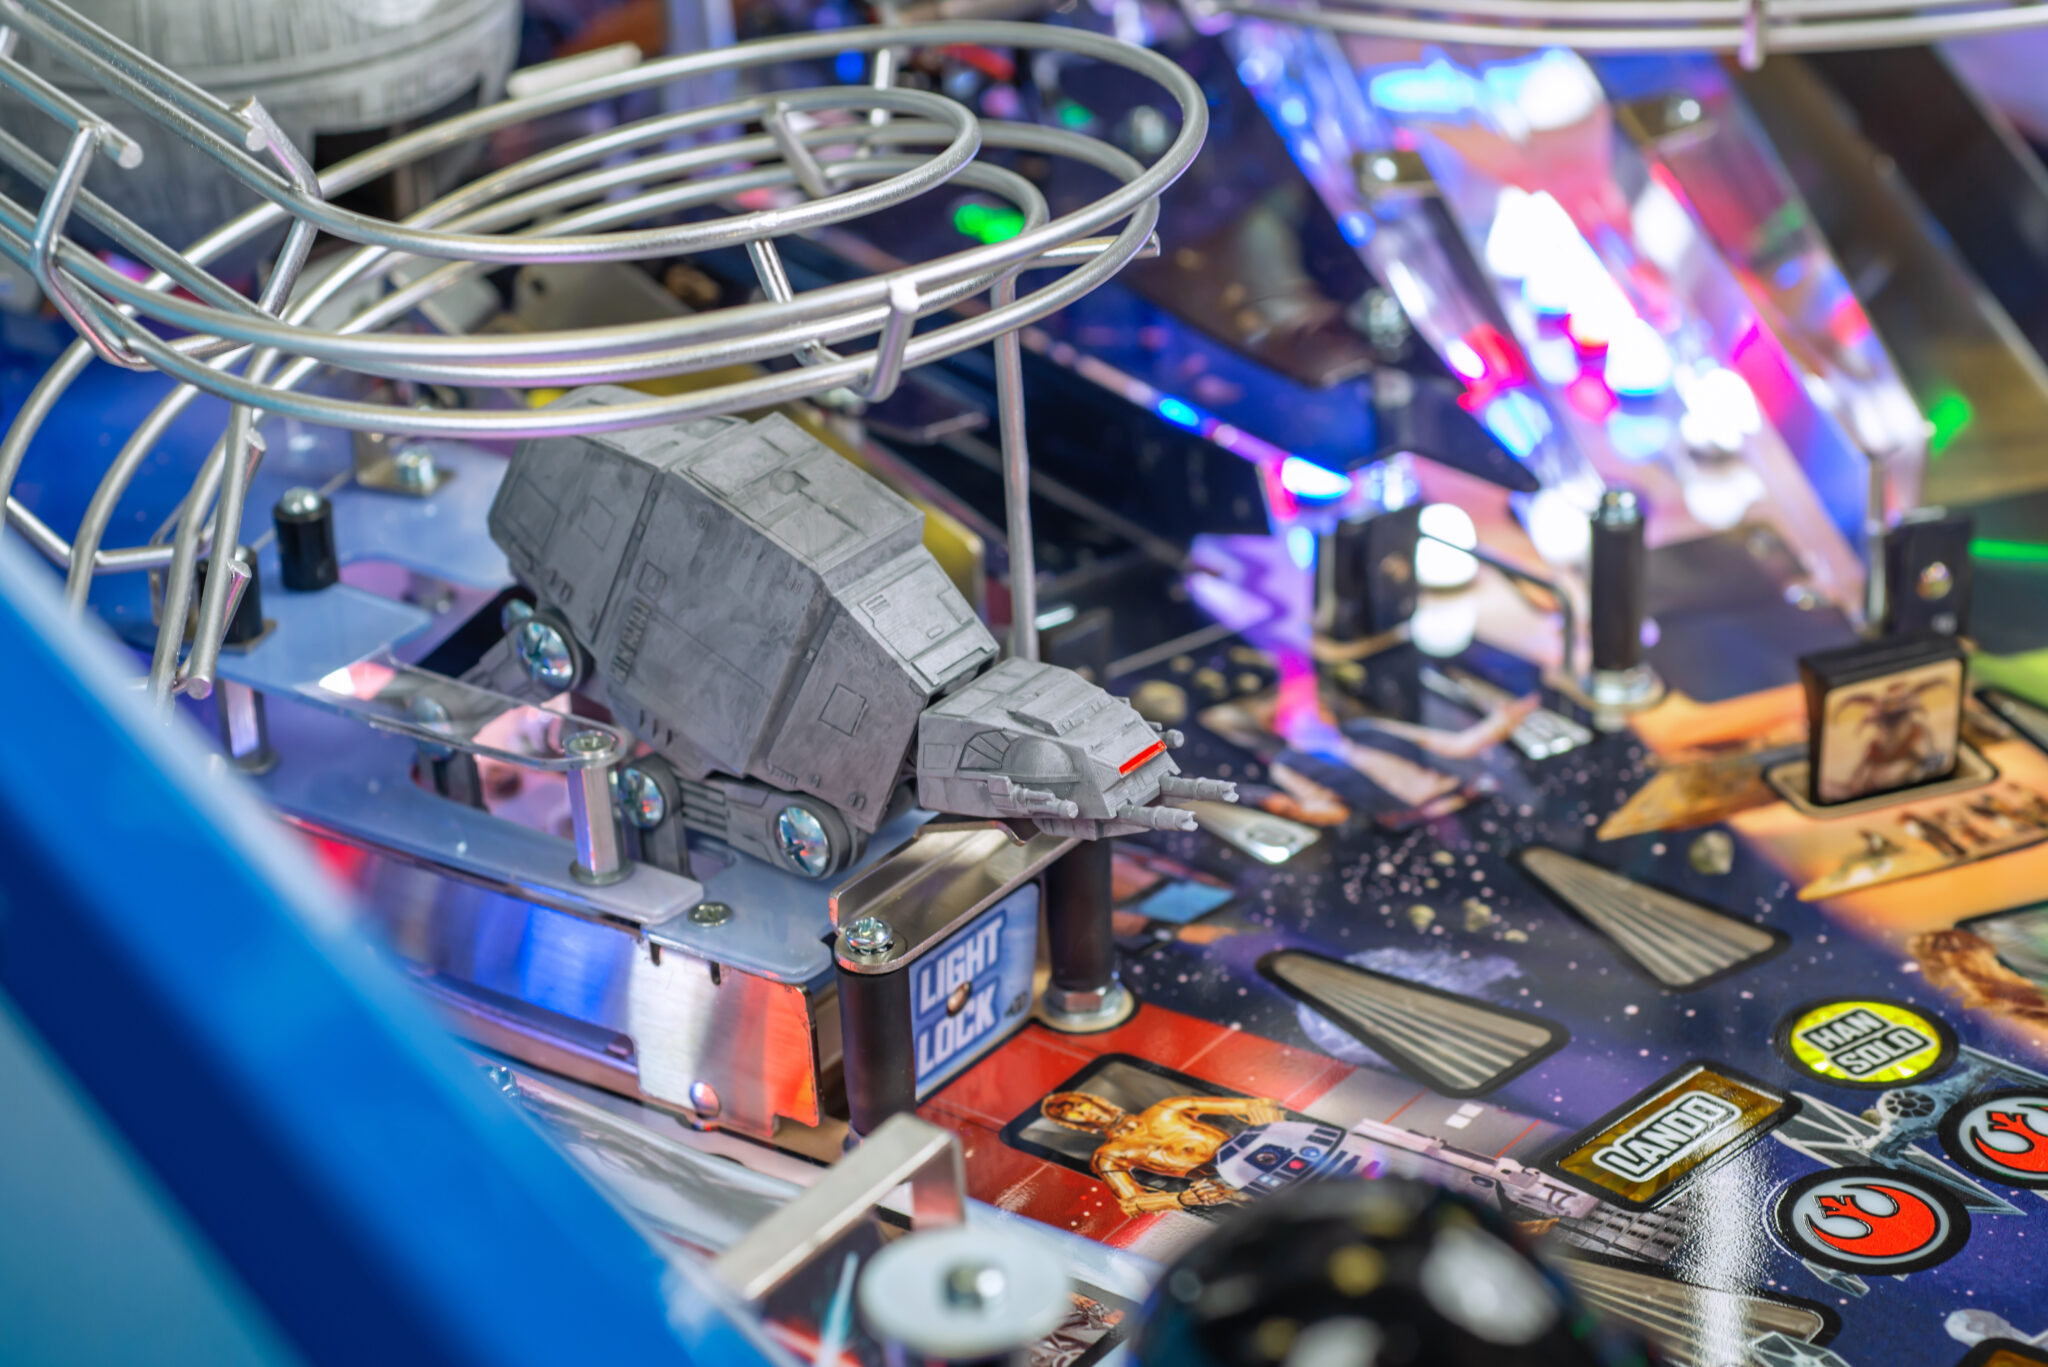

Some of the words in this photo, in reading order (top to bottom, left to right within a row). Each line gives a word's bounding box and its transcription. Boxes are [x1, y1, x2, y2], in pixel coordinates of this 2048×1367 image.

[920, 916, 1003, 1014] LIGHT
[918, 982, 996, 1077] LOCK
[1808, 1011, 1883, 1050] HAN
[1836, 1030, 1924, 1073] SOLO
[1606, 1097, 1728, 1175] LANDO
